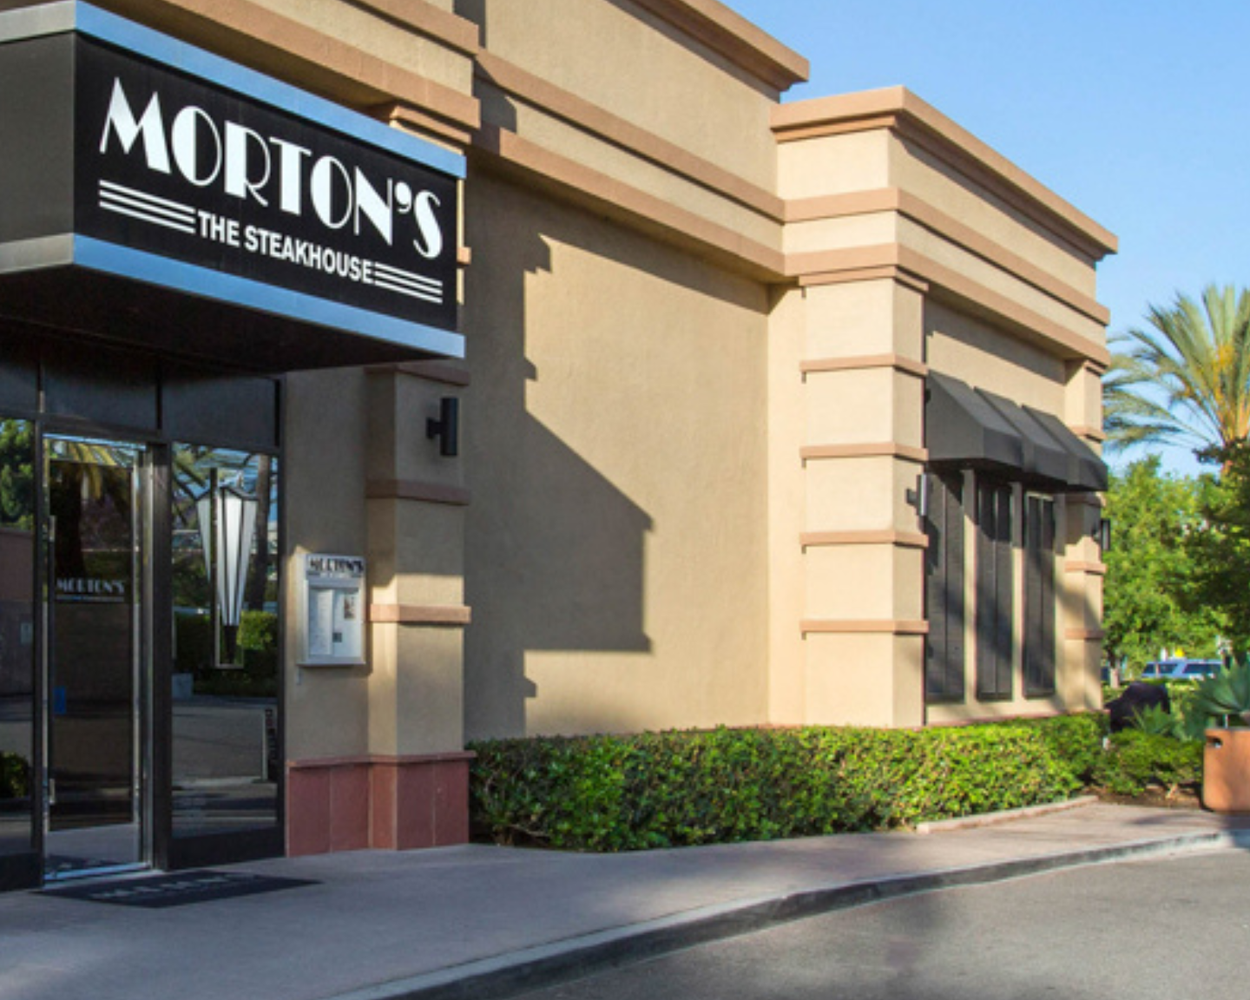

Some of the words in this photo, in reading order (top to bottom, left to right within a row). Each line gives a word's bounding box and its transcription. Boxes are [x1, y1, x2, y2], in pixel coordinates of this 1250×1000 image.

[99, 77, 443, 259] MORTON'S
[197, 210, 240, 247] THE
[245, 225, 374, 285] STEAKHOUSE
